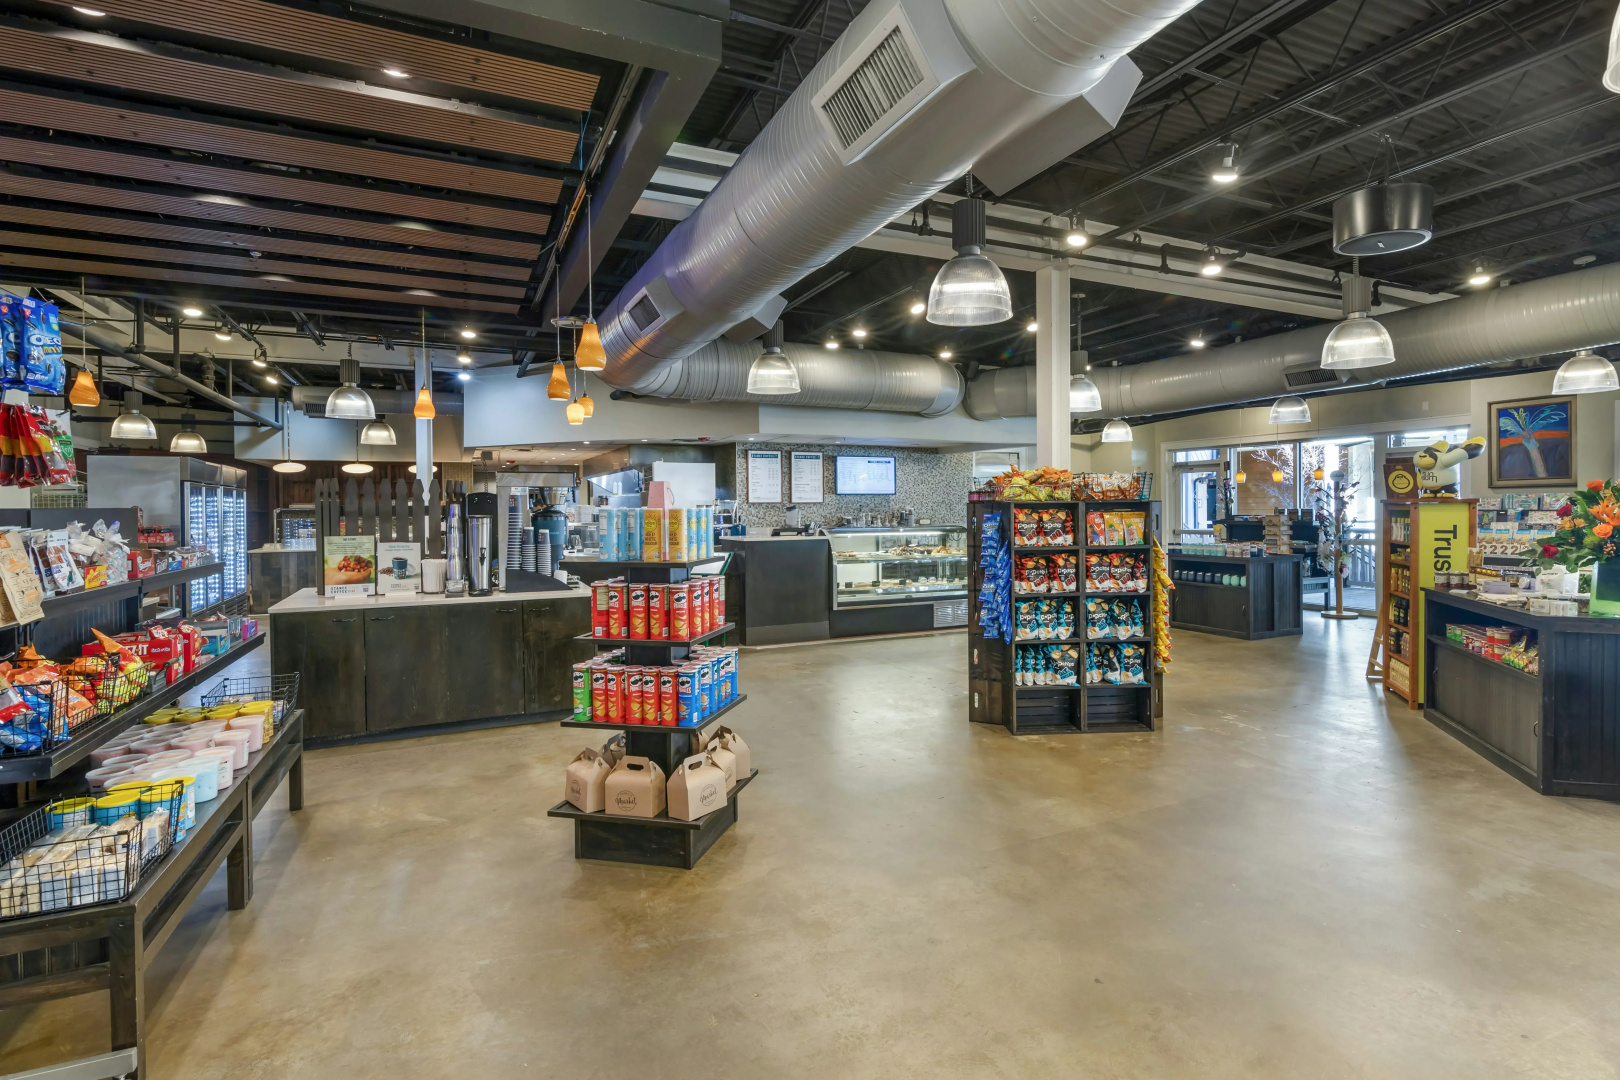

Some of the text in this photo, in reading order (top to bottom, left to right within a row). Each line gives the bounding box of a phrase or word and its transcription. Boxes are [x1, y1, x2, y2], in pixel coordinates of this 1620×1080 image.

[1434, 525, 1457, 573] Trus
[1490, 544, 1498, 555] 2
[1500, 544, 1508, 555] 2
[1510, 545, 1519, 555] 2
[615, 797, 638, 806] Market
